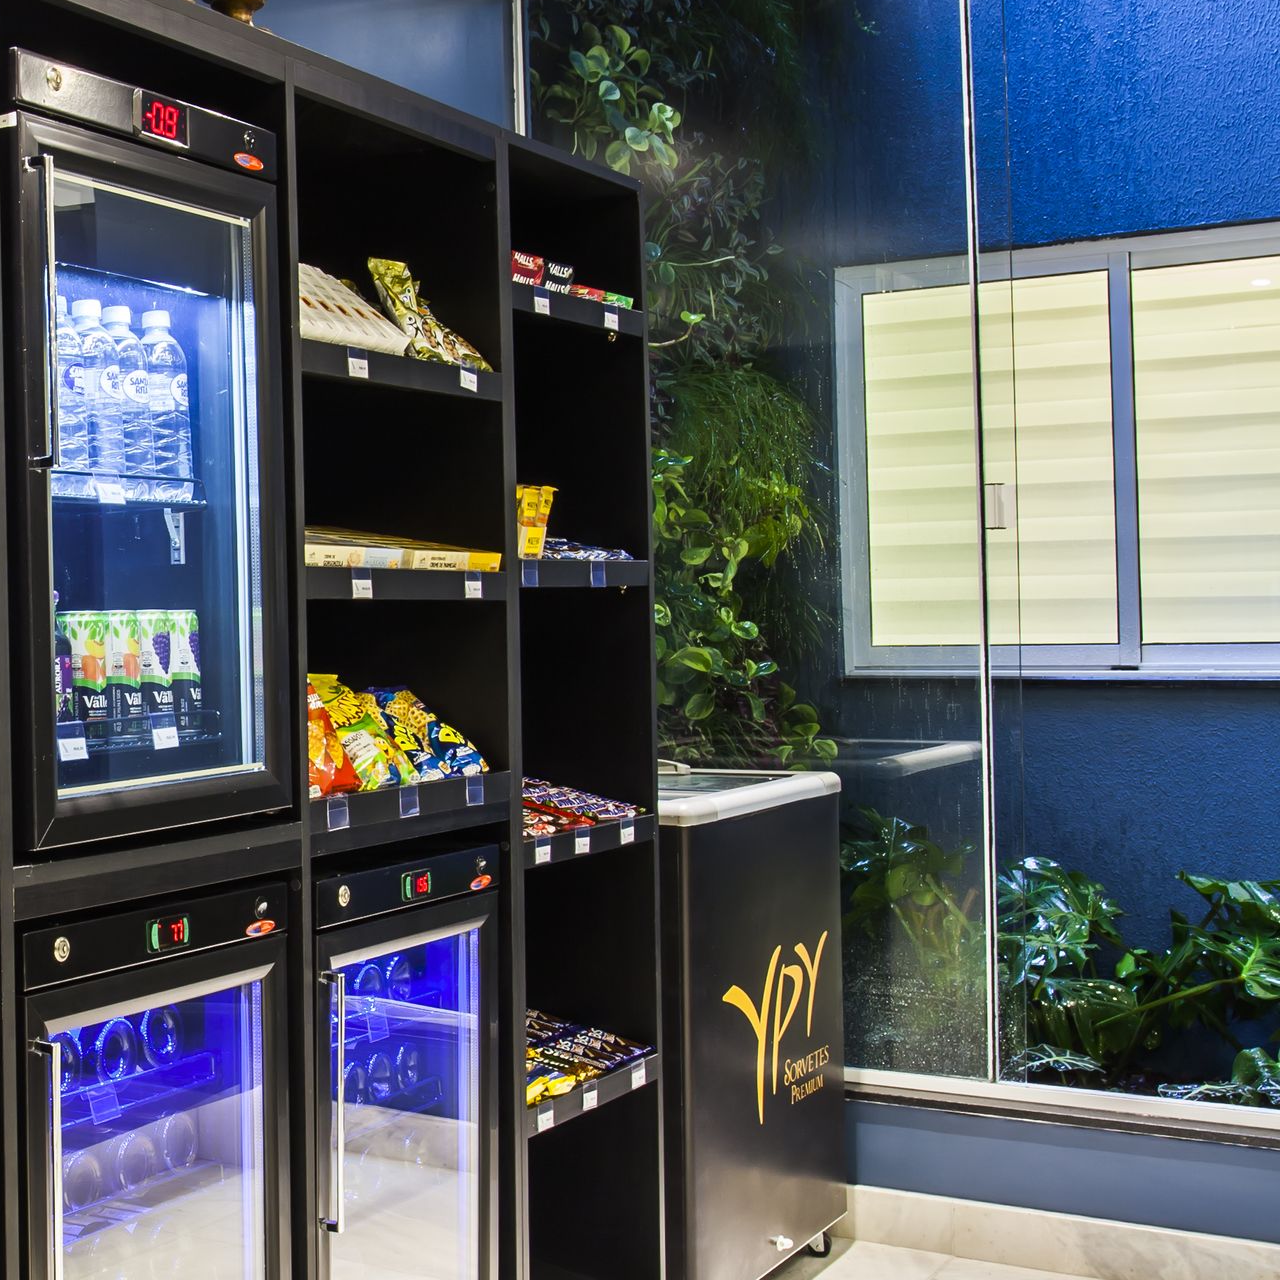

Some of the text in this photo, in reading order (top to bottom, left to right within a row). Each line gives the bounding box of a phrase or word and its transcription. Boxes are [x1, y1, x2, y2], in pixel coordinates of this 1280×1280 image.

[514, 252, 534, 269] HALLS
[722, 930, 827, 1125] YPY
[784, 1045, 829, 1086] SORVETES
[791, 1074, 823, 1105] PREMIUM
